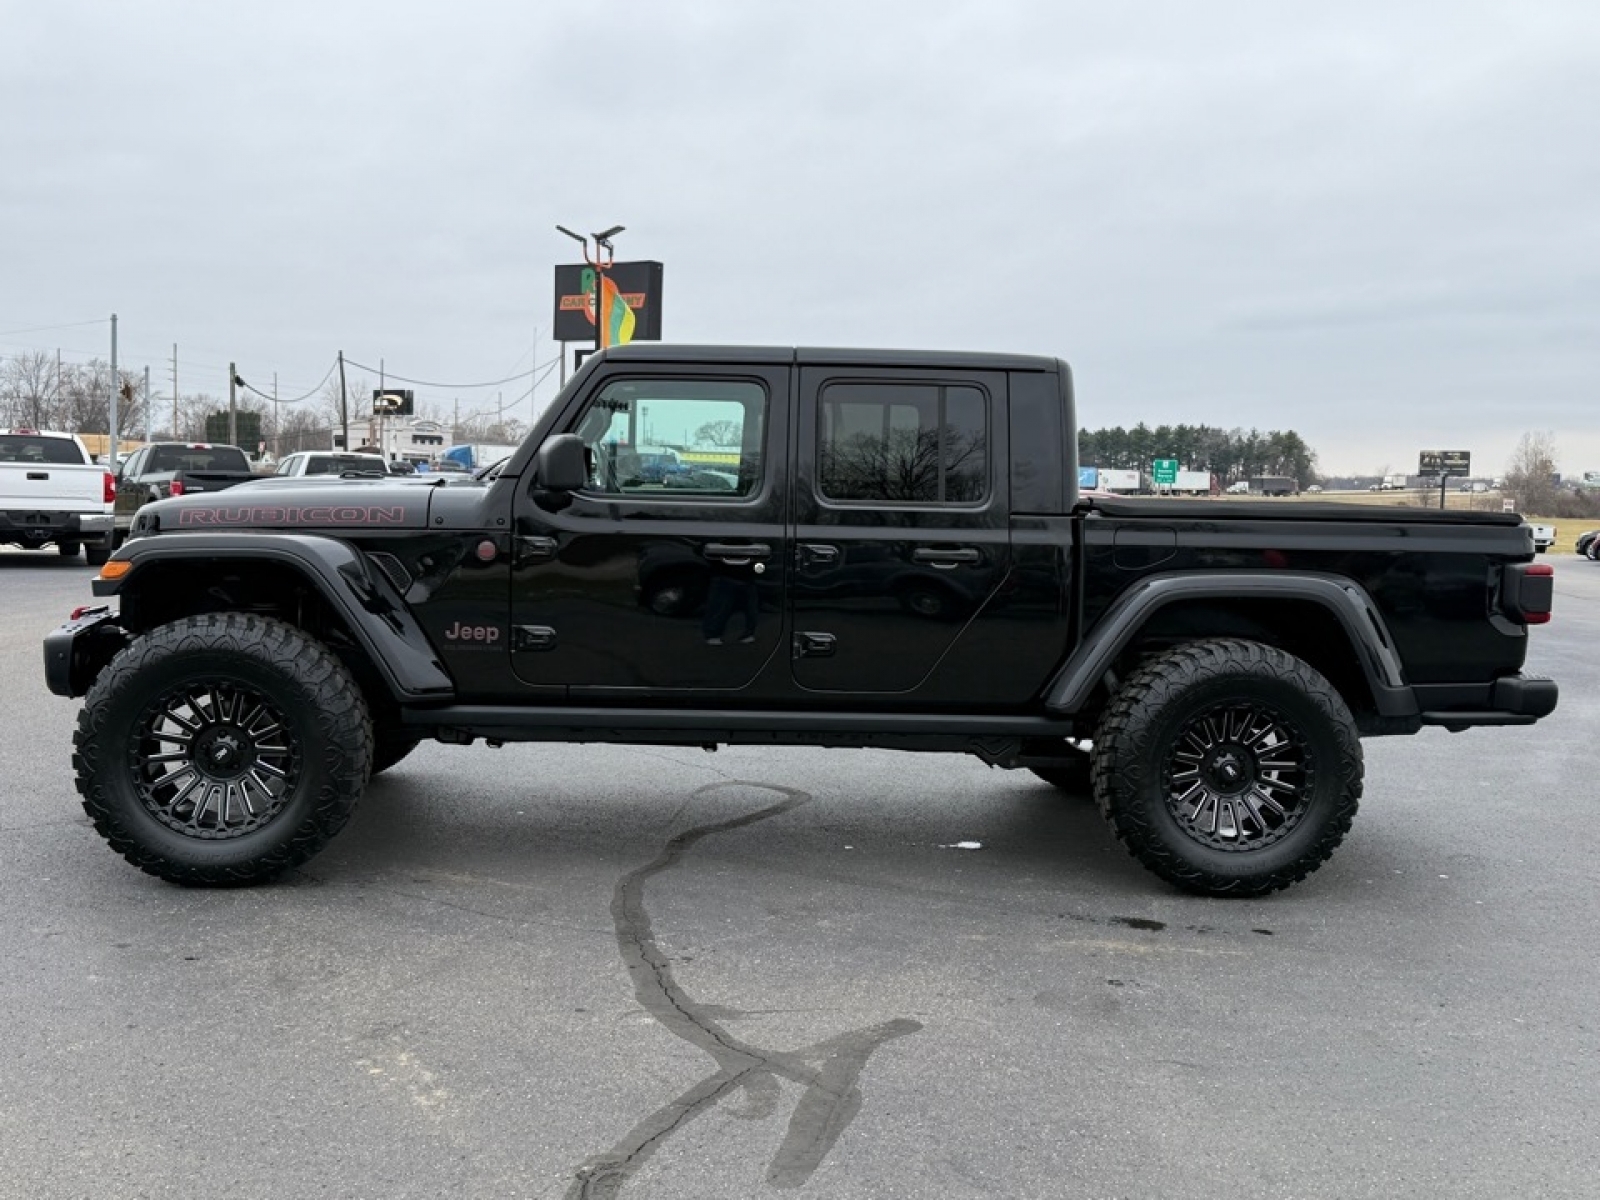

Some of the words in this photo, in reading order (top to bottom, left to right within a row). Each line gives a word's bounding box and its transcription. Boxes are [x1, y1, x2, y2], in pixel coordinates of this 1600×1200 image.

[562, 297, 585, 308] CAR
[179, 506, 404, 524] RUBICON
[445, 621, 499, 644] Jeep
